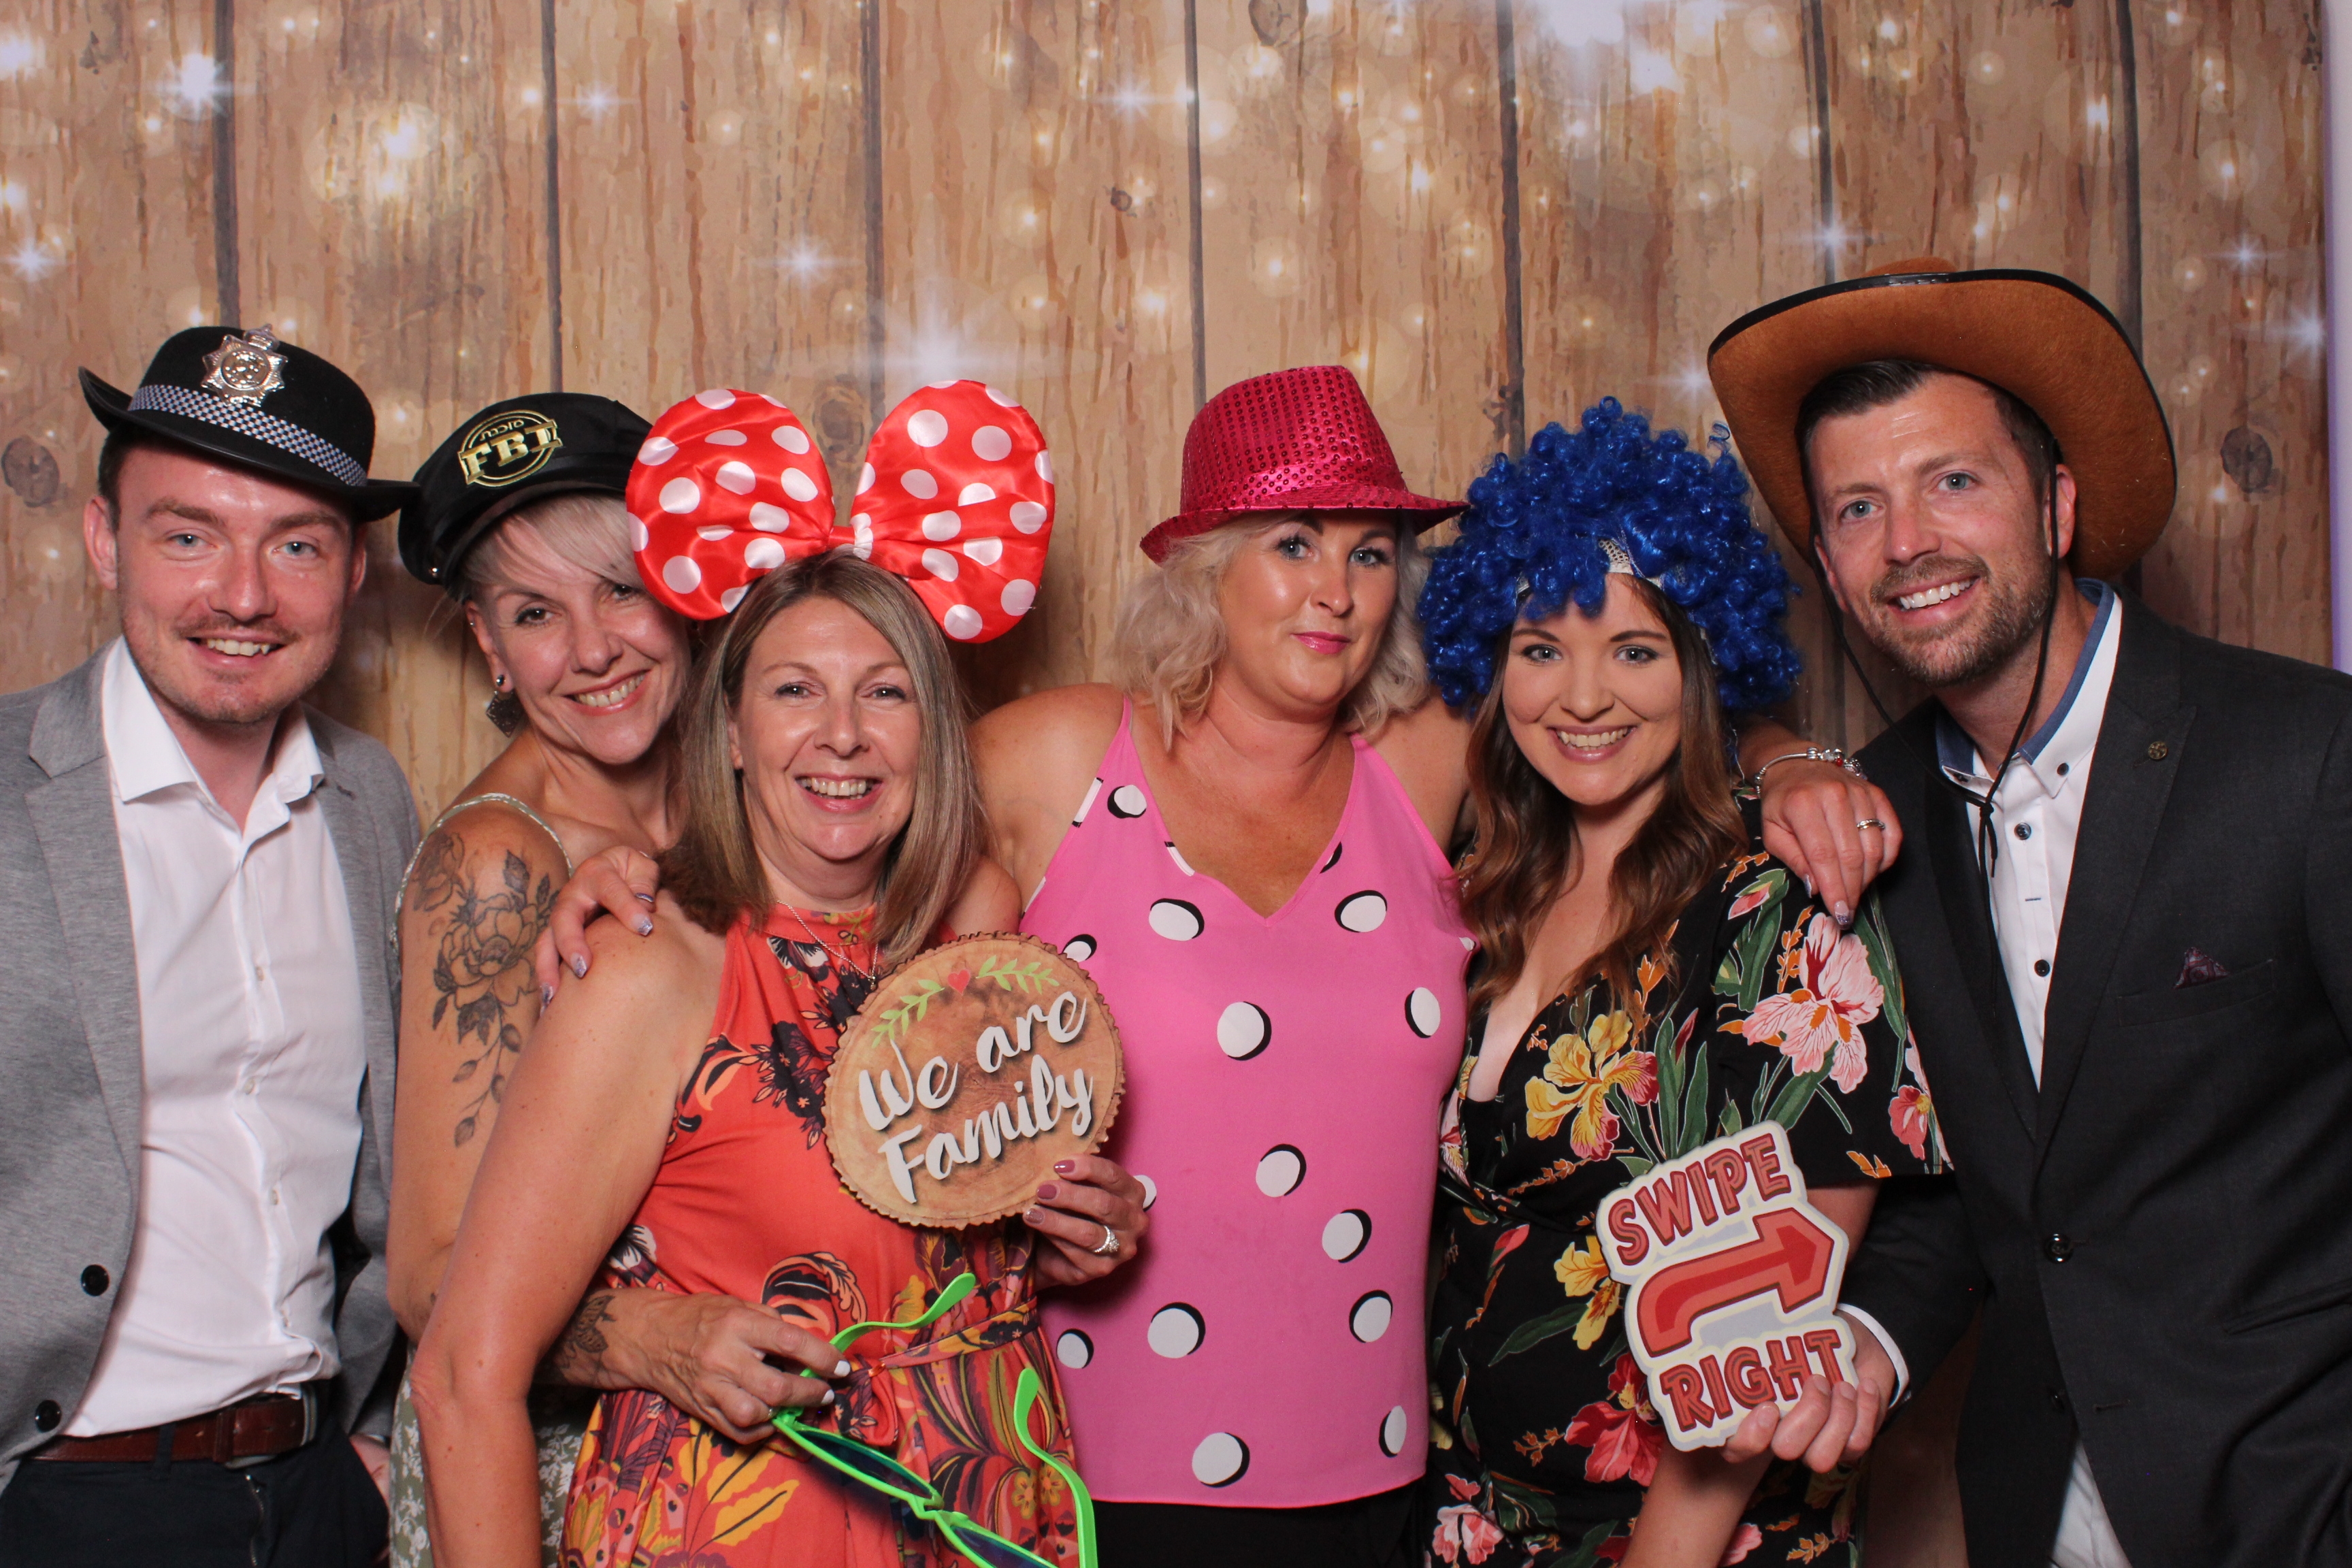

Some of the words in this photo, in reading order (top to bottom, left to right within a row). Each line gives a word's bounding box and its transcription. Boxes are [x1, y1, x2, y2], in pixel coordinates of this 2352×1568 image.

[458, 419, 564, 485] FBI
[858, 1039, 959, 1131] We
[976, 991, 1087, 1074] are
[878, 1054, 1094, 1204] Family
[1608, 1132, 1791, 1266] SWIPE
[1659, 1328, 1844, 1433] RIGHT
